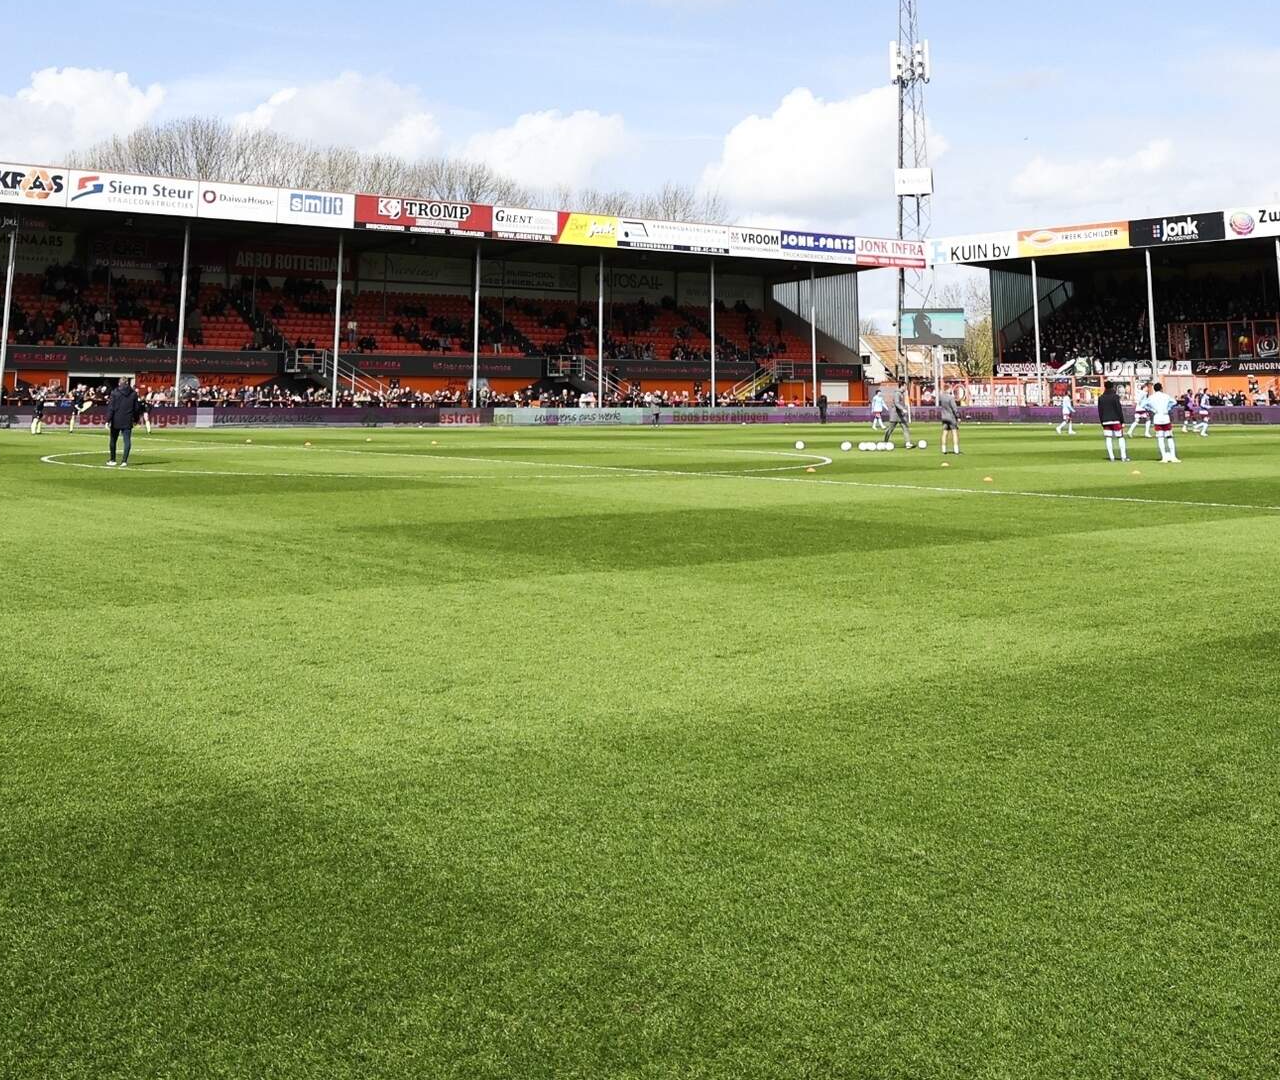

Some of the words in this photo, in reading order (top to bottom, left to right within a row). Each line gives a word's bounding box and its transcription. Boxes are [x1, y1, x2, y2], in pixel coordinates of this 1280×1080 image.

[108, 179, 148, 197] Siem
[152, 185, 194, 201] Steur
[289, 193, 344, 216] smit
[405, 201, 471, 220] TROMP
[741, 233, 779, 246] VROOM
[781, 233, 855, 251] JONK-PARTS
[1084, 229, 1119, 239] SCHILDER
[858, 239, 887, 253] JONK
[892, 241, 924, 256] INFRA
[950, 242, 988, 261] KUIN
[992, 243, 1011, 258] bv
